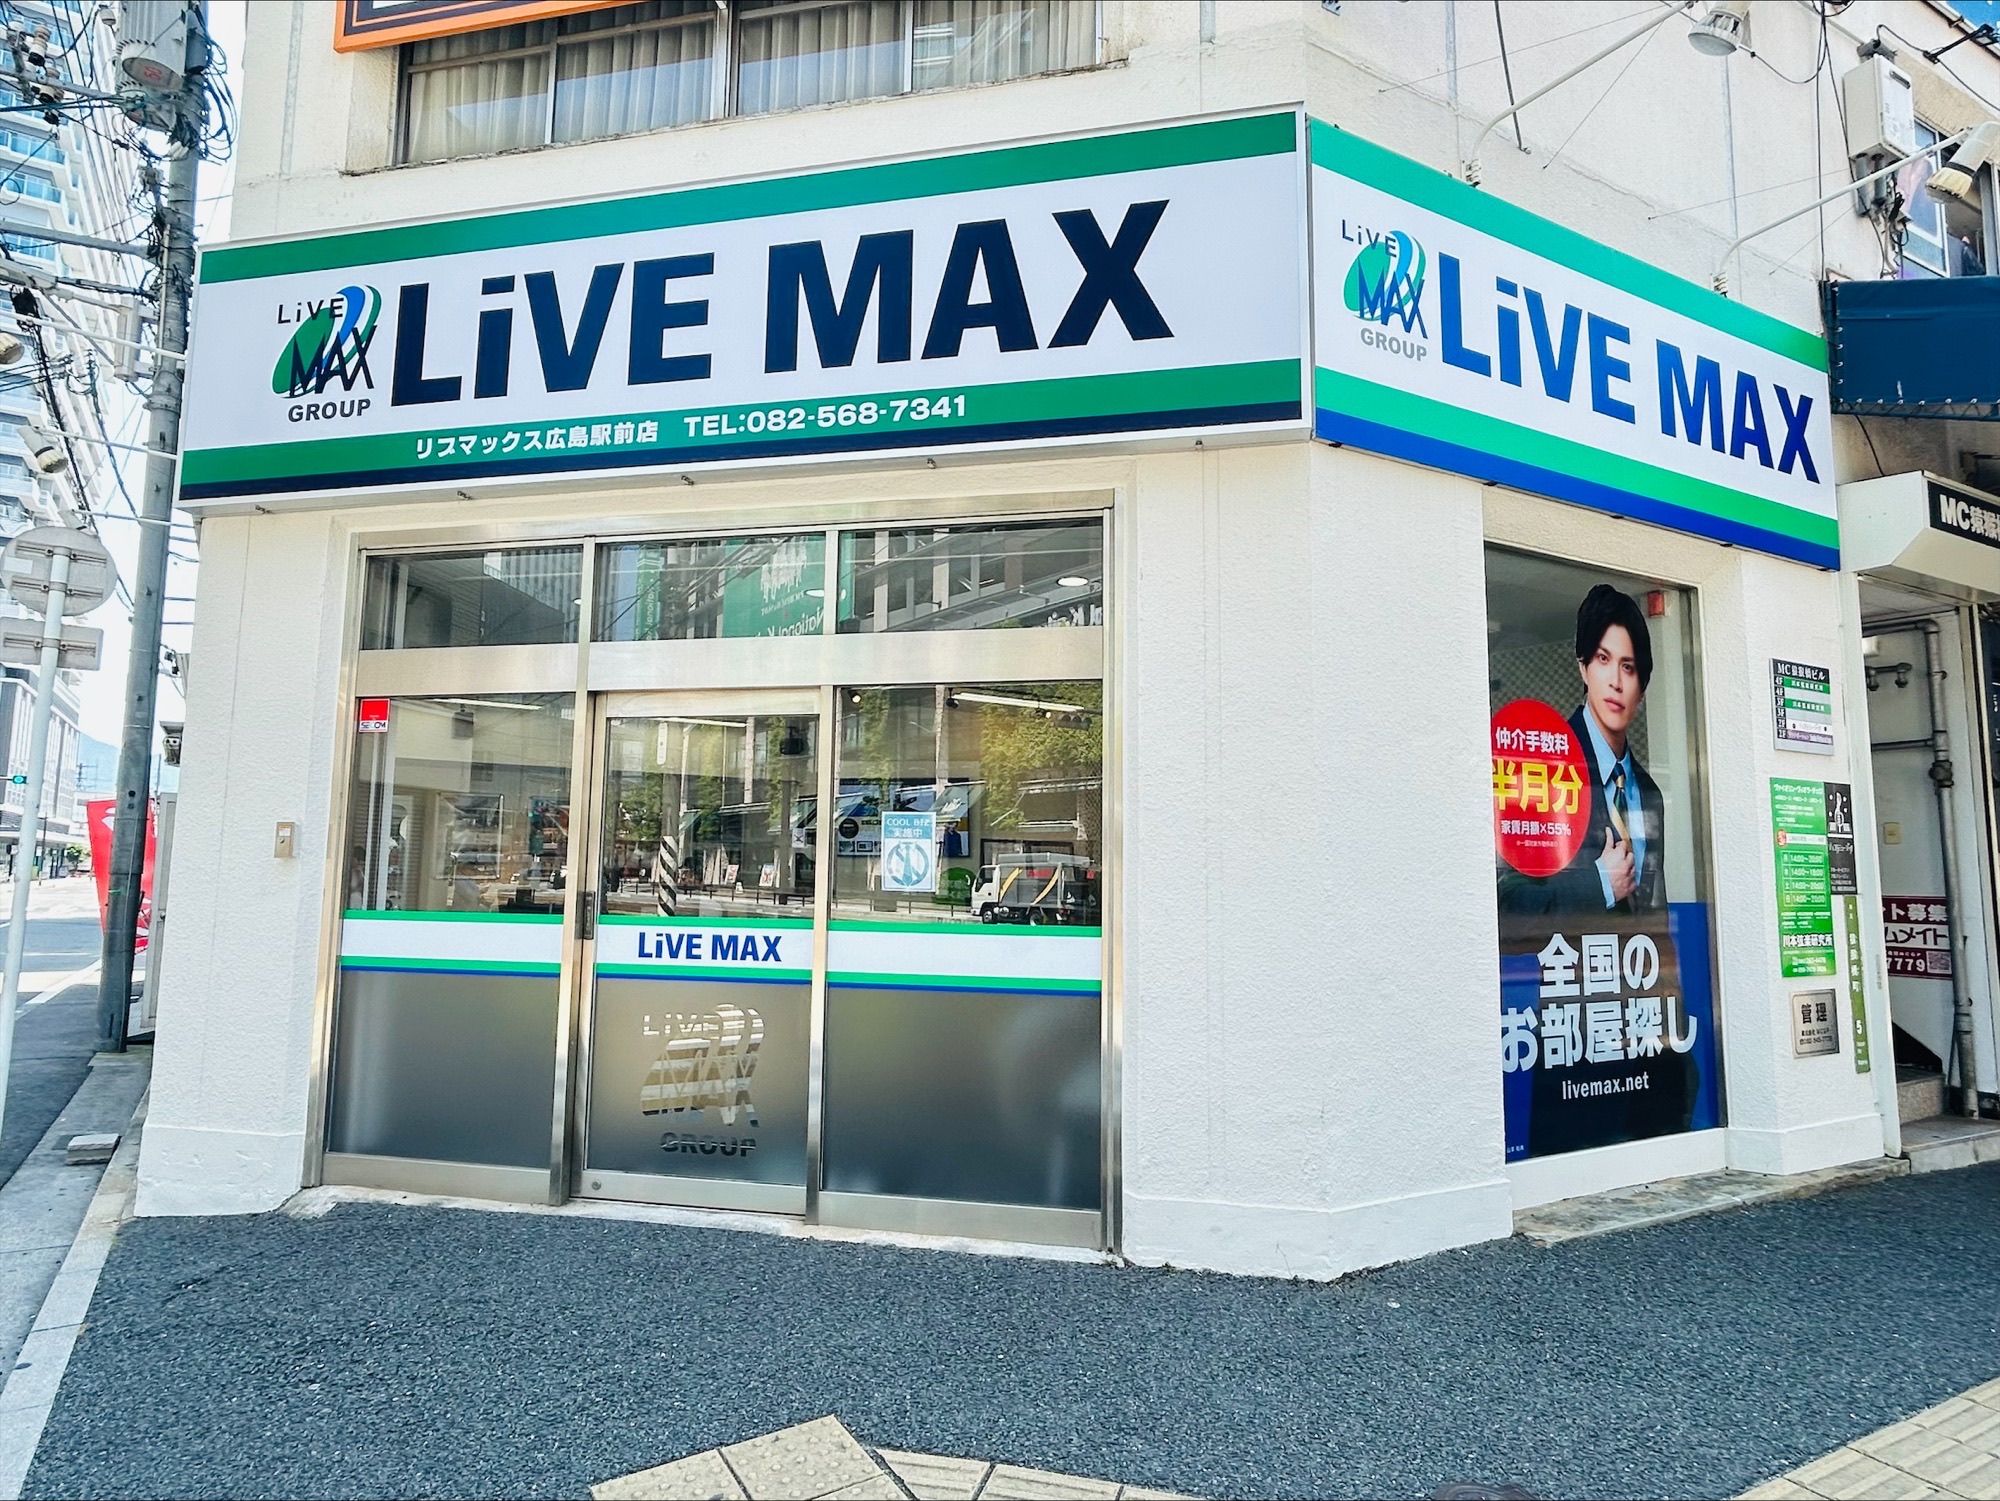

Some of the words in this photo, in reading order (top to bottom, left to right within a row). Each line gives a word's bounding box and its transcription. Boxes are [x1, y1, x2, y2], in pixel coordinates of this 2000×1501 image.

[1342, 219, 1397, 258] LiVE
[278, 297, 344, 325] LiVE
[391, 252, 715, 406] LiVE
[764, 199, 1175, 374] MAX
[1358, 256, 1428, 340] MAX
[289, 325, 378, 399] MAX
[1360, 327, 1428, 362] GROUP
[1438, 251, 1636, 425] LiVE
[1656, 338, 1821, 485] MAX
[288, 398, 371, 423] GROUP
[683, 394, 967, 438] TEL:082-568-7341
[1496, 726, 1569, 756] 仲介手数料
[1493, 758, 1583, 815] 半月分
[886, 818, 911, 826] COOL
[638, 931, 703, 960] LiVE
[711, 934, 782, 962] MAX
[1537, 933, 1659, 998] 全国の
[1501, 996, 1698, 1074] お部屋探し
[1856, 1020, 1862, 1034] 5
[1562, 1071, 1650, 1101] livemax.net
[661, 1132, 756, 1157] GROUP
